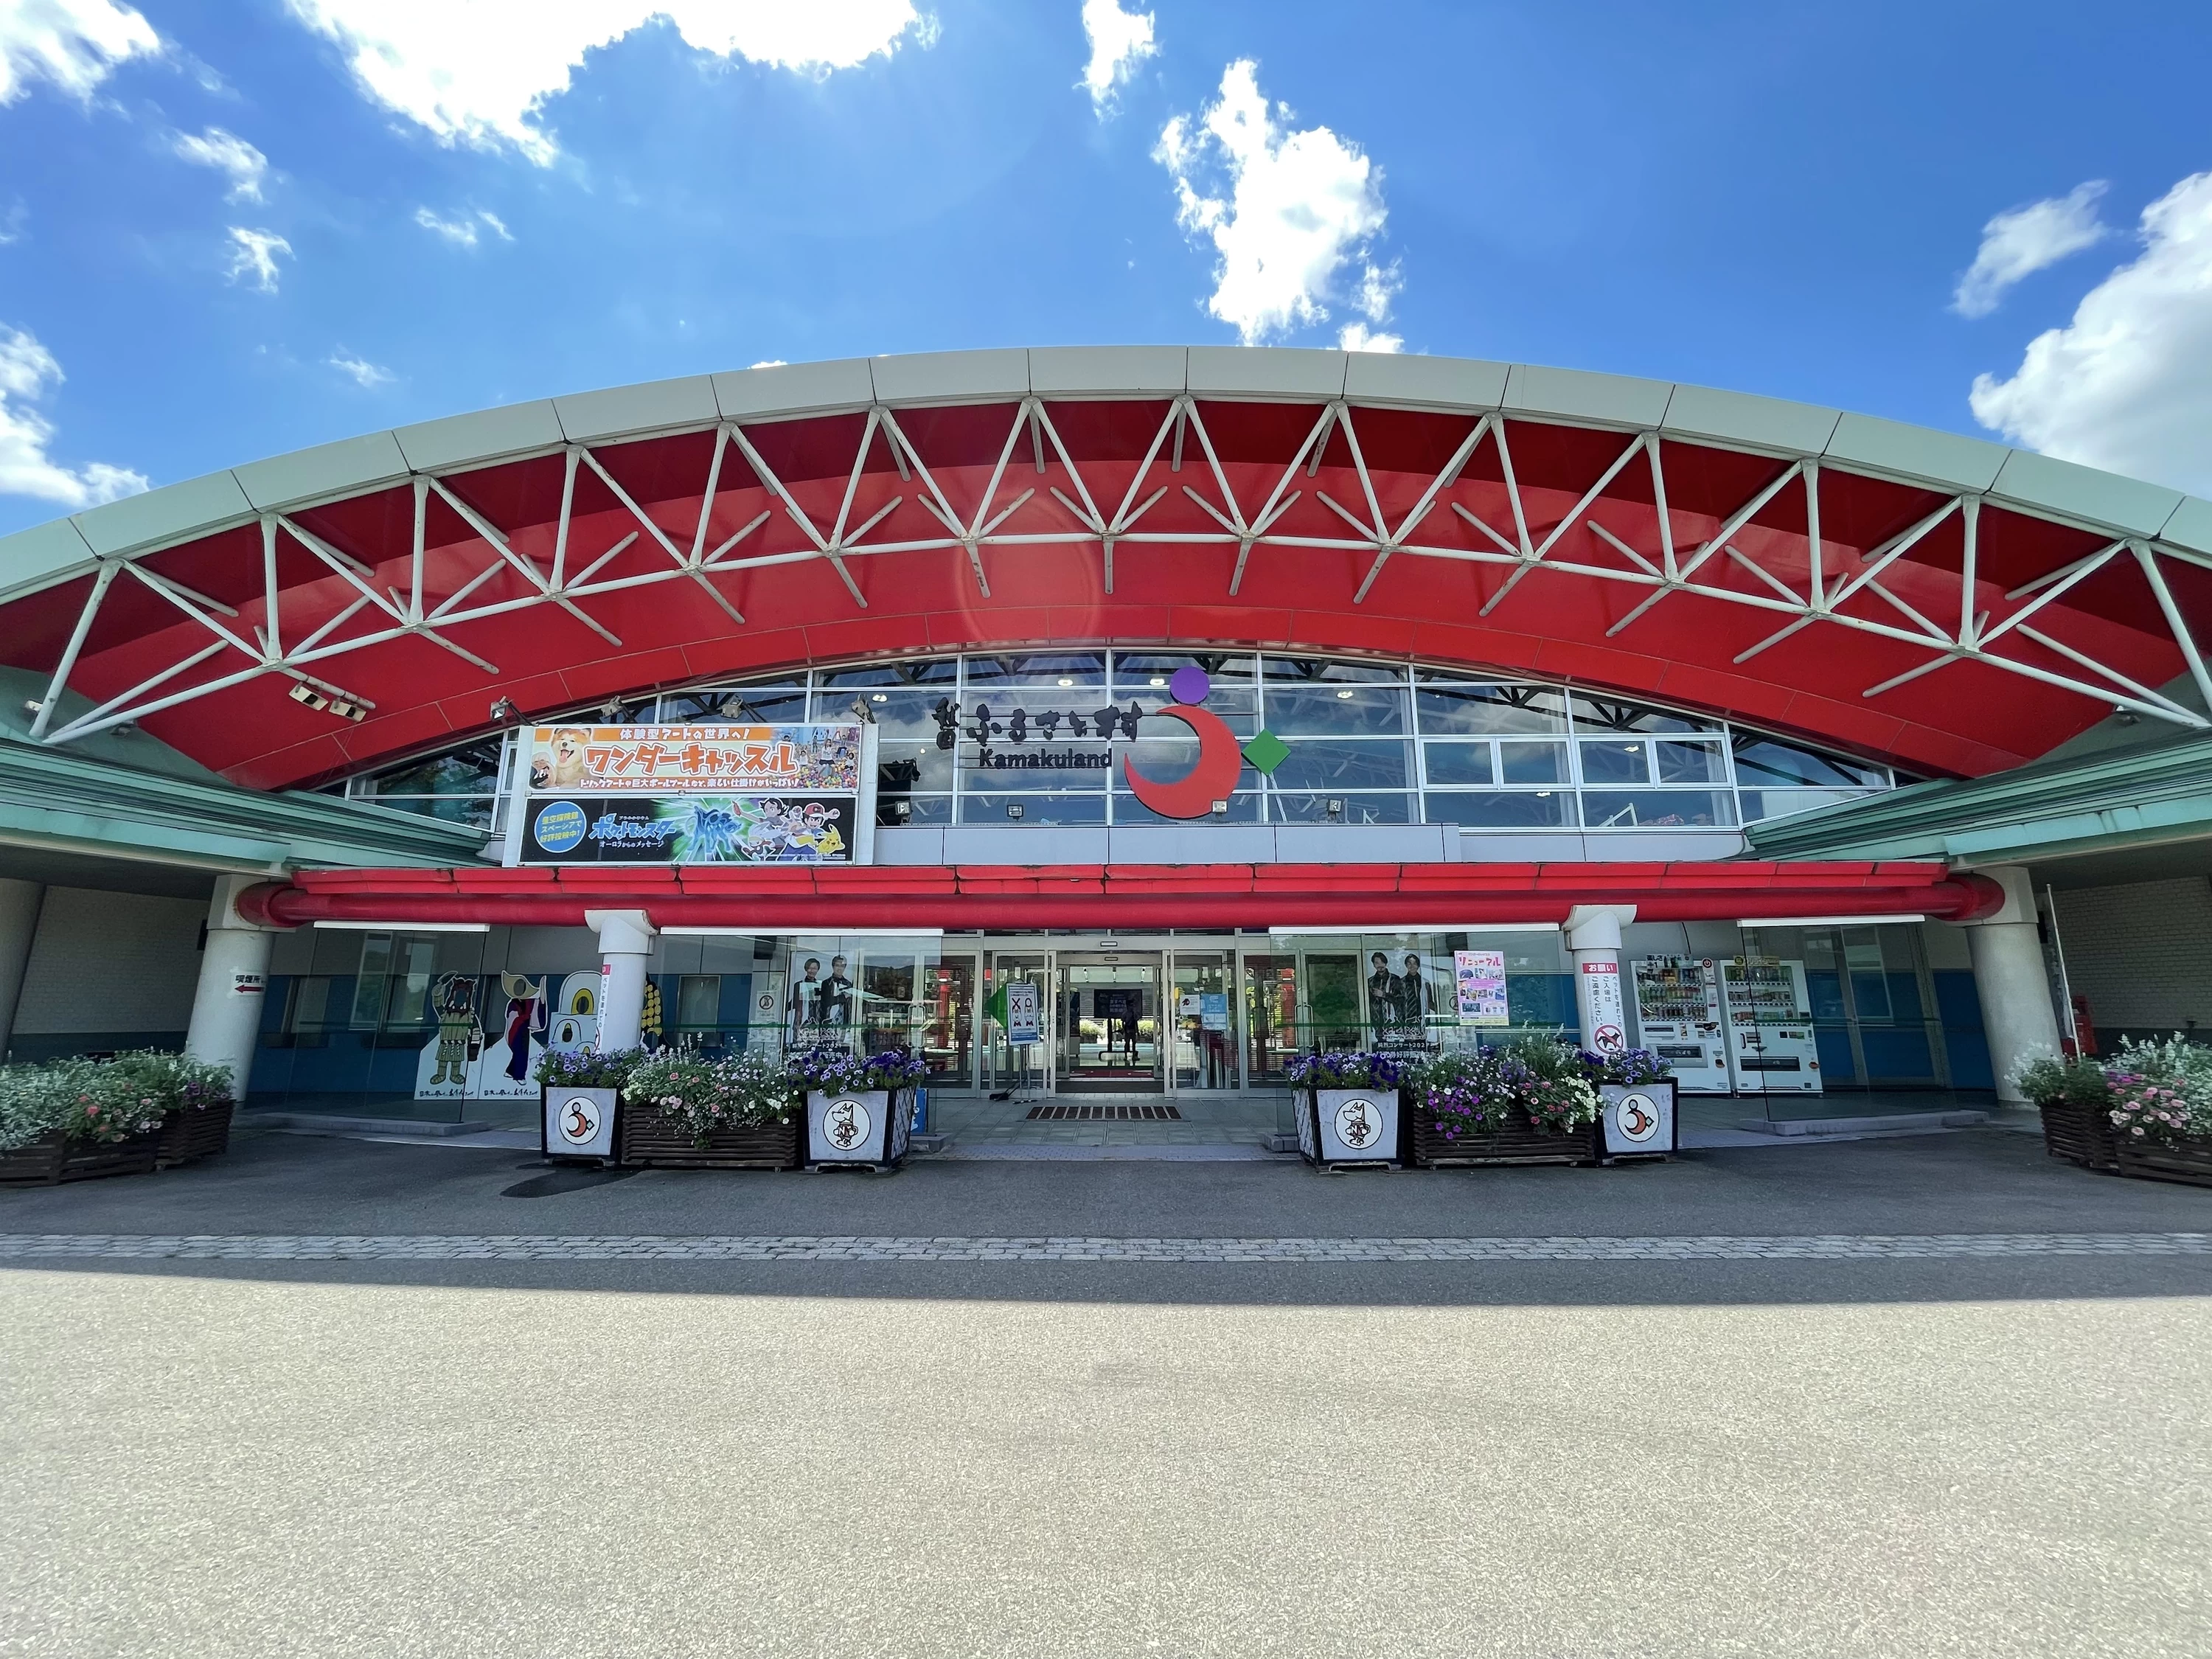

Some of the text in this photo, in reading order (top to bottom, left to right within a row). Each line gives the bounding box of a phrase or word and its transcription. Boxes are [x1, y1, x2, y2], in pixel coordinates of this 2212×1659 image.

[583, 740, 799, 775] ワンダーキャッスル
[979, 748, 1112, 768] Kamakuland
[588, 813, 676, 841] ポケットモンスター
[599, 840, 665, 849] オーロラからのメッセージ
[1458, 956, 1501, 967] リニューアル
